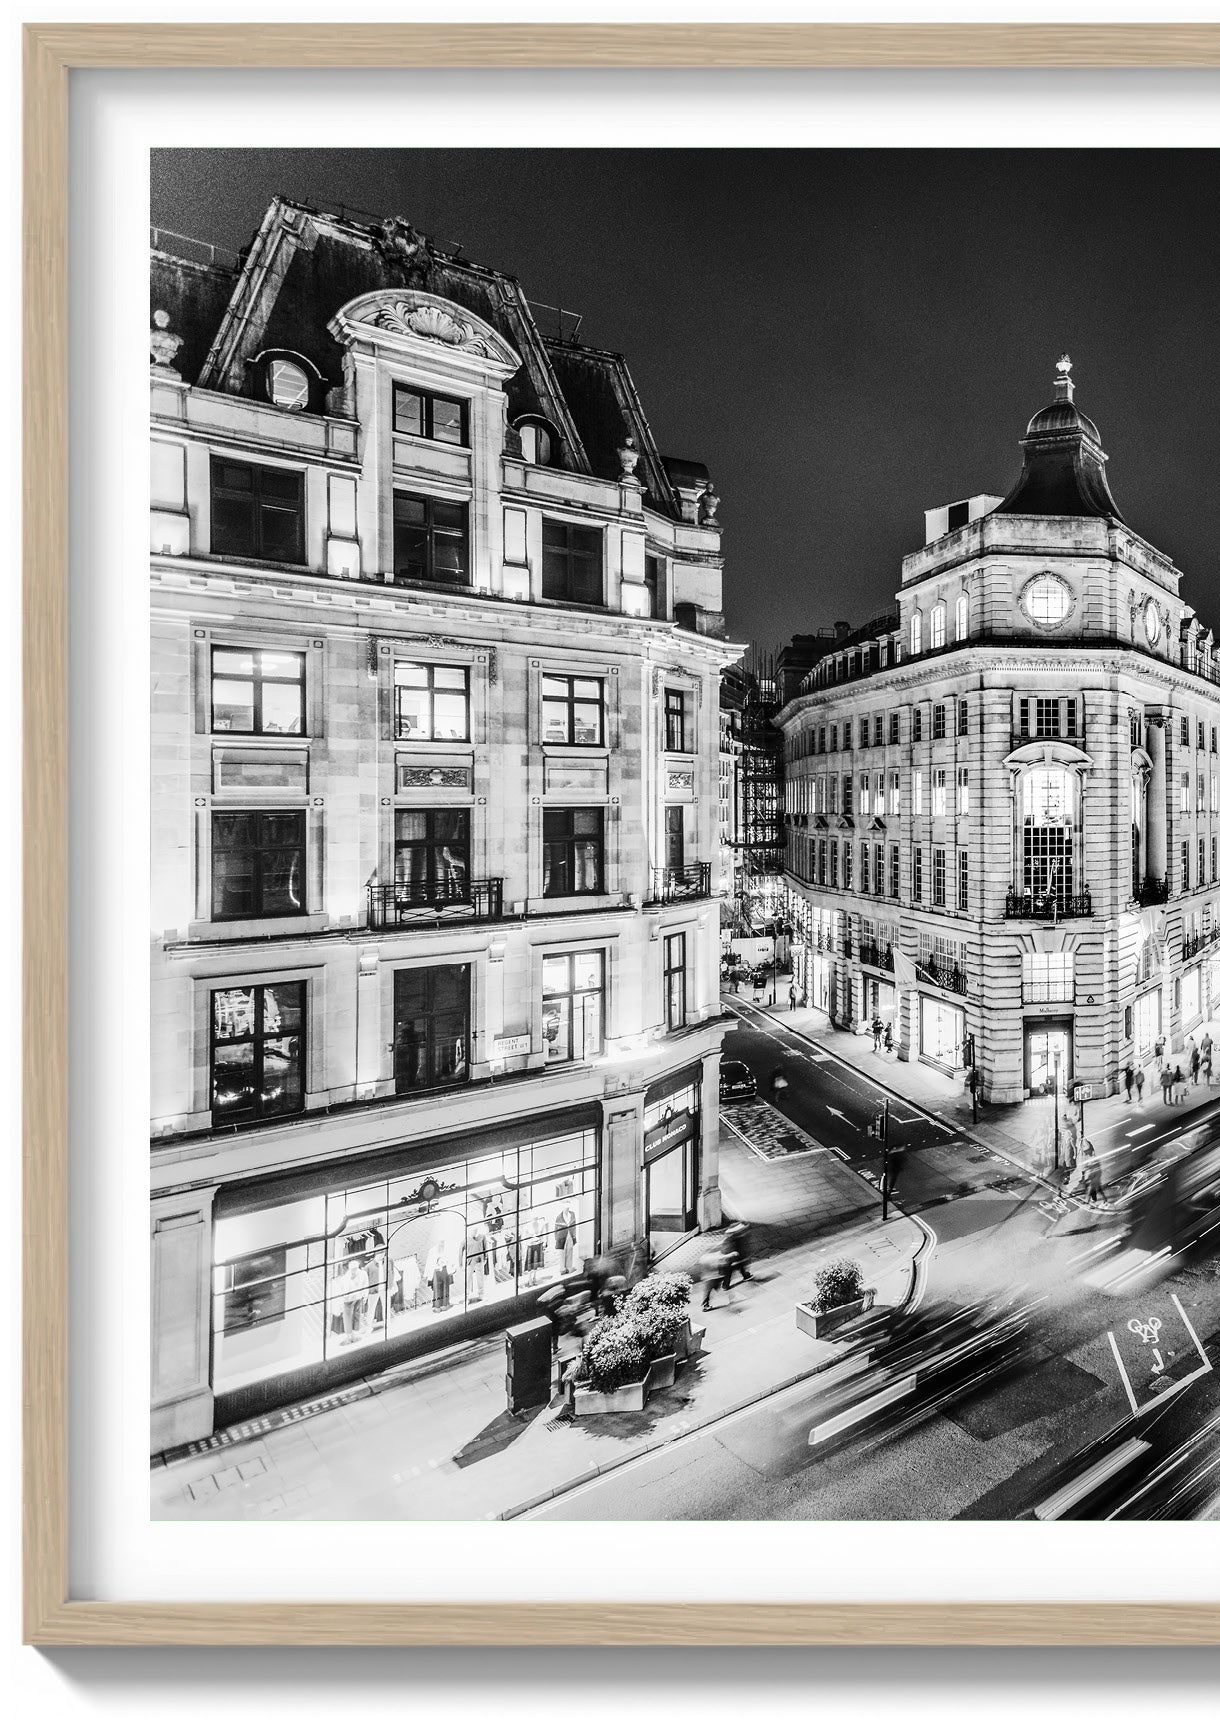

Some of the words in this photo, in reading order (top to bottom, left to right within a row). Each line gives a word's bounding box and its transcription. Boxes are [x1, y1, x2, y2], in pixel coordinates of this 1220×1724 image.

[497, 1038, 519, 1046] REGENT
[497, 1043, 518, 1051] STREET
[645, 1138, 662, 1152] CLUB
[662, 1123, 687, 1142] MONACO
